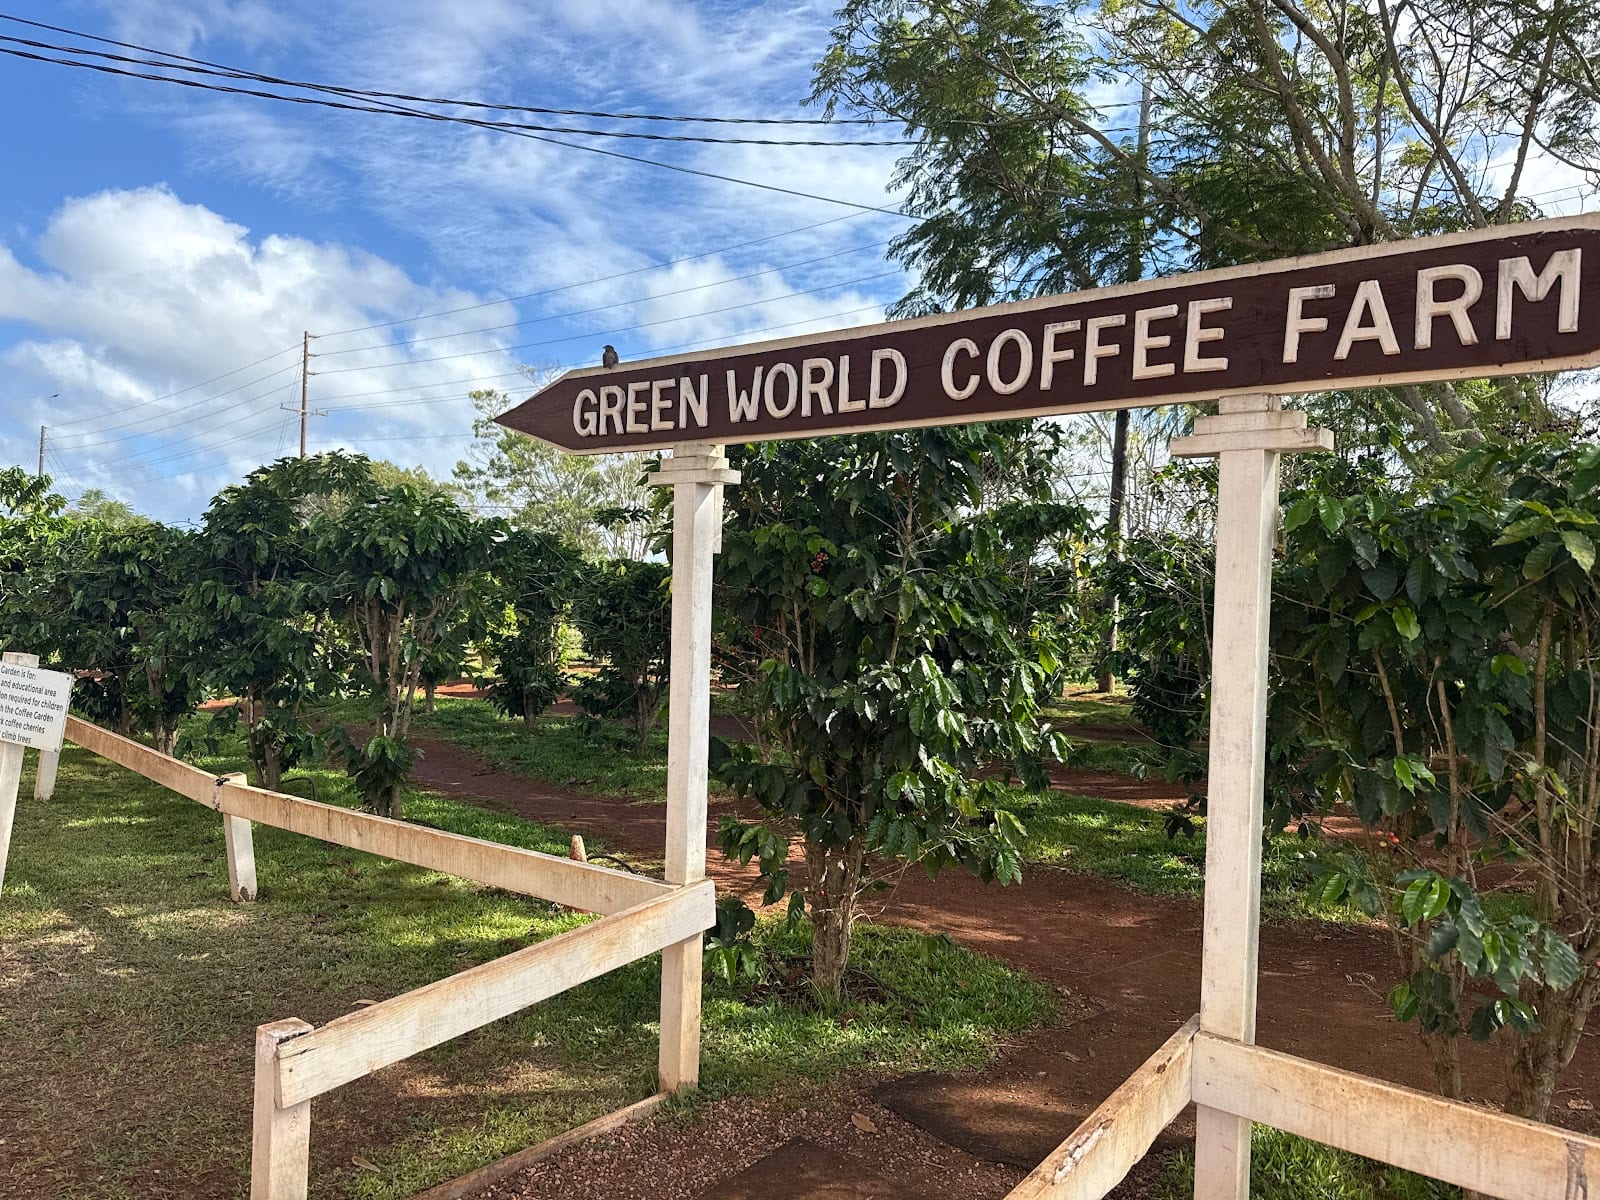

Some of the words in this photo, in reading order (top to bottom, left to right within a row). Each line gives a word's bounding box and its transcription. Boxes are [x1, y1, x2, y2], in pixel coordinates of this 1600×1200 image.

[572, 374, 709, 437] GREEN
[726, 348, 908, 424] WORLD
[941, 297, 1233, 400] COFFEE
[1283, 248, 1582, 364] FARM
[1, 665, 20, 677] Garden
[21, 669, 26, 678] is
[1, 679, 11, 688] and
[12, 681, 44, 695] educational
[44, 688, 57, 698] area
[9, 693, 31, 706] required
[32, 698, 40, 707] for
[41, 701, 64, 712] children
[5, 704, 14, 715] the
[14, 707, 33, 719] Coffee
[33, 711, 54, 723] Garden
[5, 718, 22, 729] coffee
[23, 721, 45, 734] cherries
[2, 730, 16, 741] climb
[17, 733, 32, 745] trees
